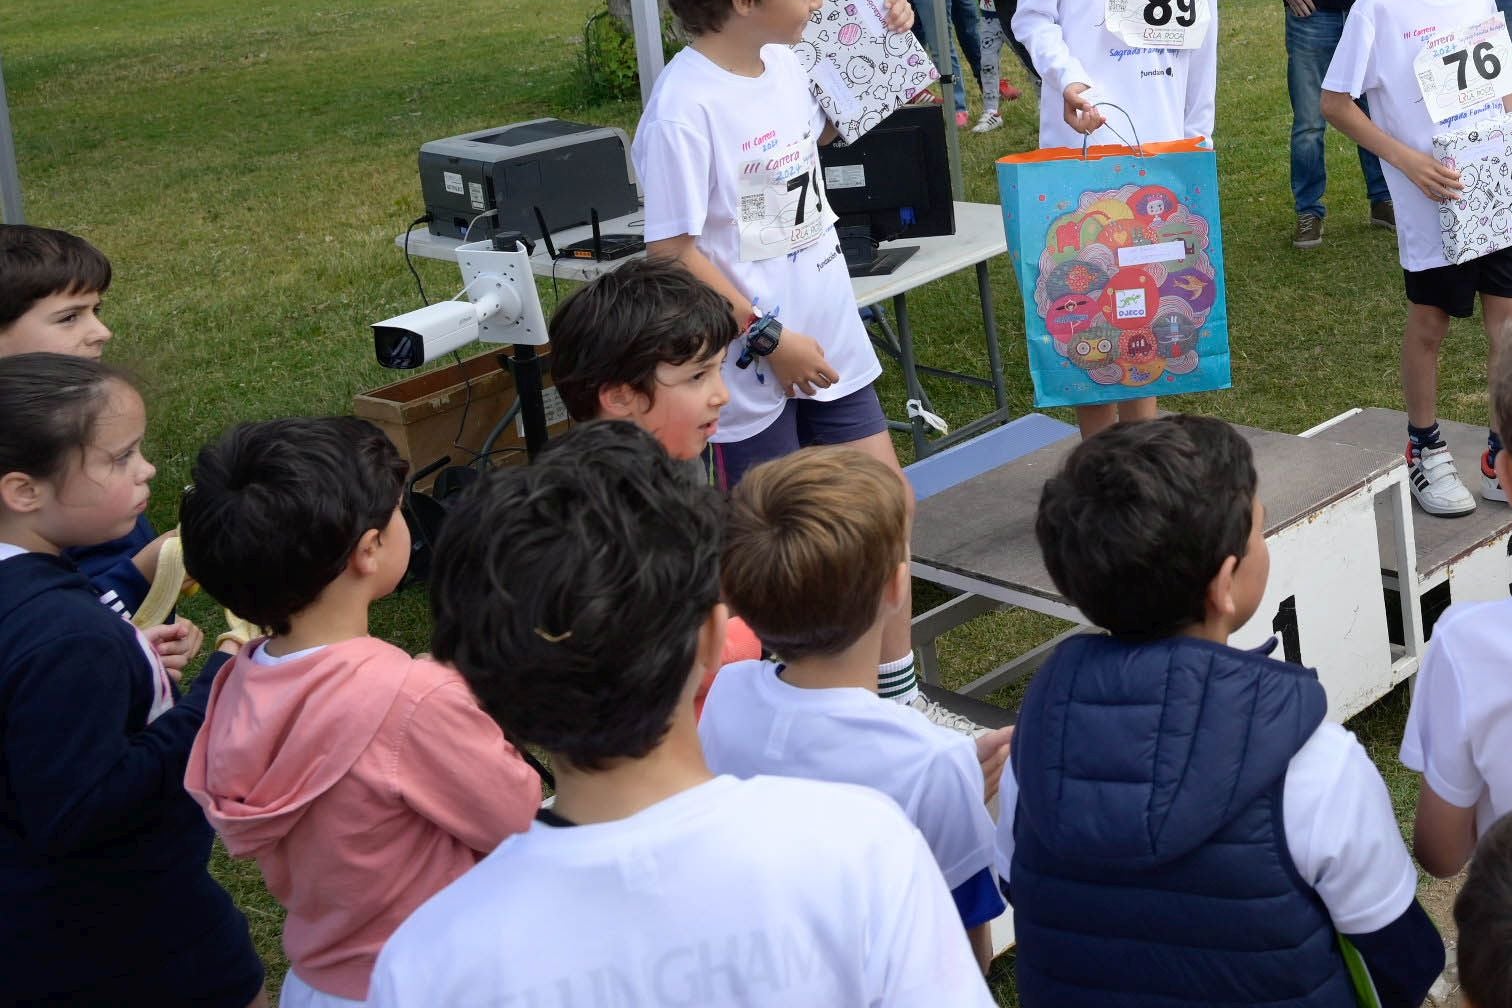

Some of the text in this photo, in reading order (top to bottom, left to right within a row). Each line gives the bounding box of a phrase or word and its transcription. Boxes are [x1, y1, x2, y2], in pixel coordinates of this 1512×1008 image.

[1413, 26, 1436, 37] Carrera
[1442, 42, 1501, 91] 76
[753, 130, 776, 149] Carrera
[743, 162, 760, 174] III
[765, 150, 800, 171] Carrera
[774, 166, 801, 182] 2024
[1118, 309, 1145, 318] DJECO
[1272, 594, 1303, 665] 1
